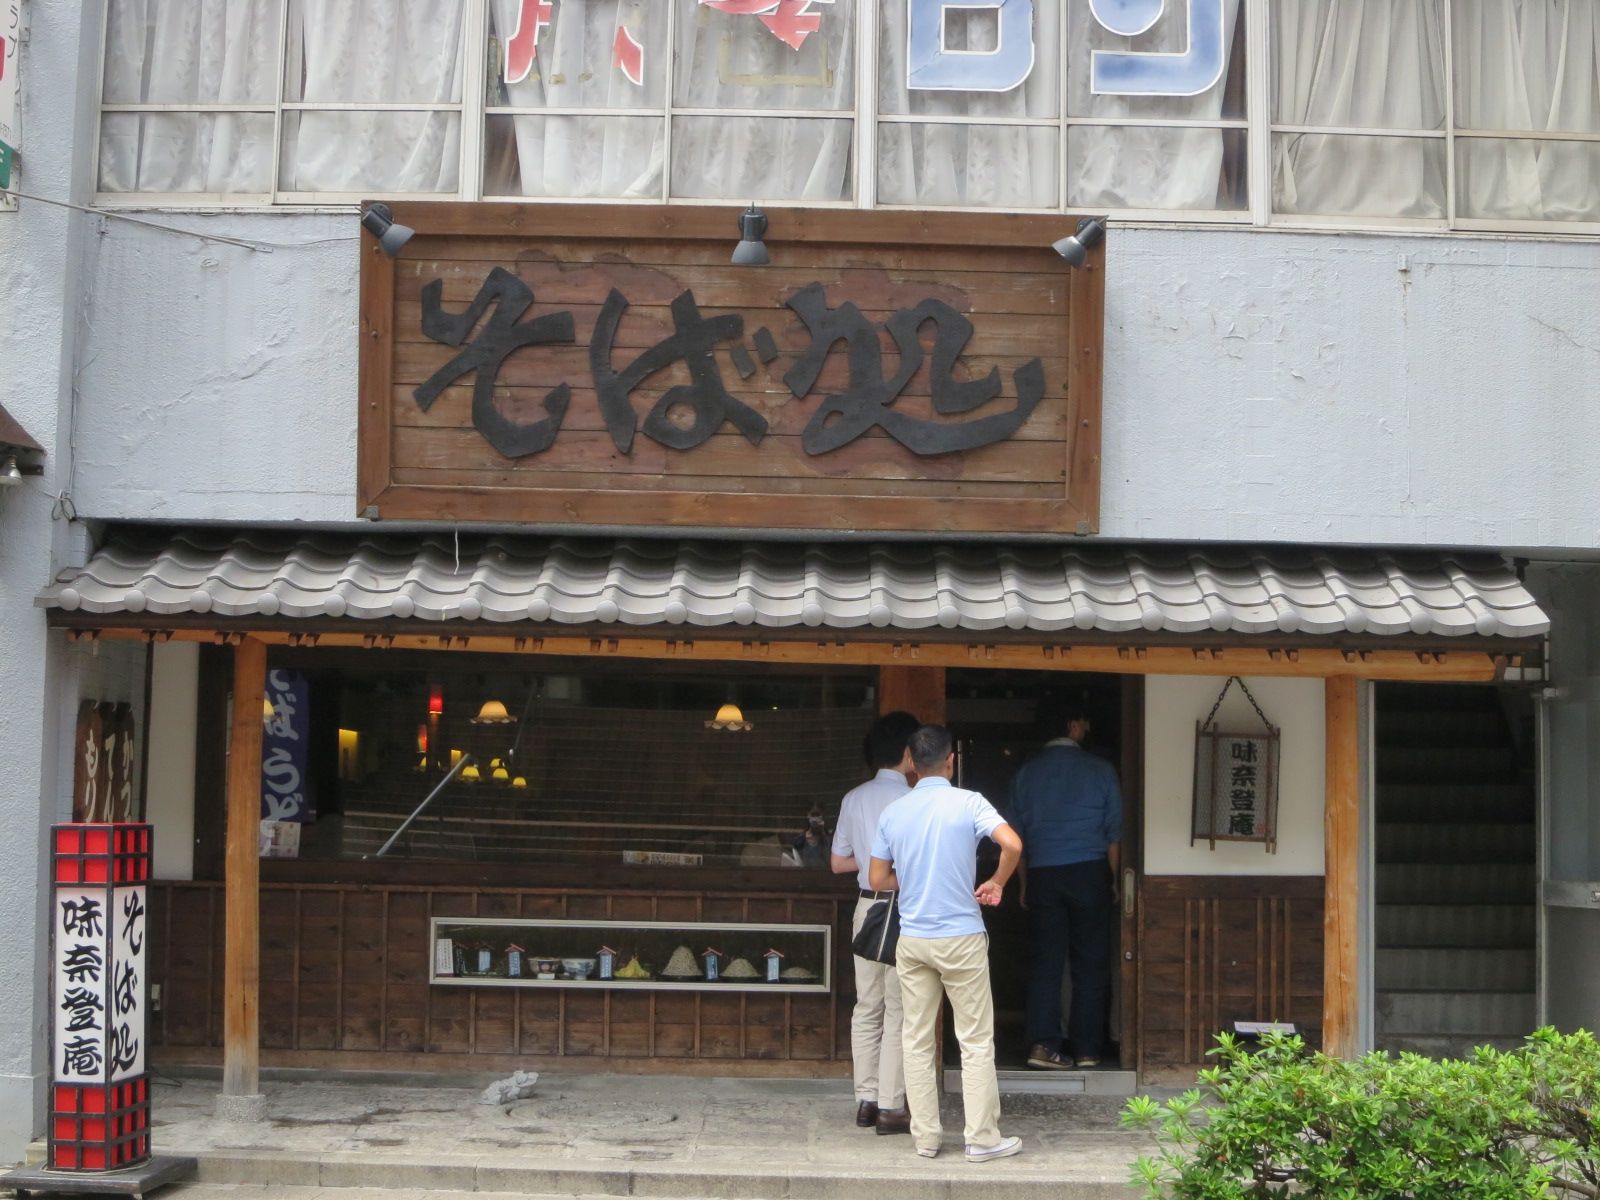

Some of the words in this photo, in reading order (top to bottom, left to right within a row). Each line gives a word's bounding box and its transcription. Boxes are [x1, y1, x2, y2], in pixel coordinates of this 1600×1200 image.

[412, 266, 1047, 459] そば処
[1228, 740, 1258, 836] 味奈登庵
[61, 895, 104, 1076] 味奈登庵
[111, 890, 145, 1077] そば処
